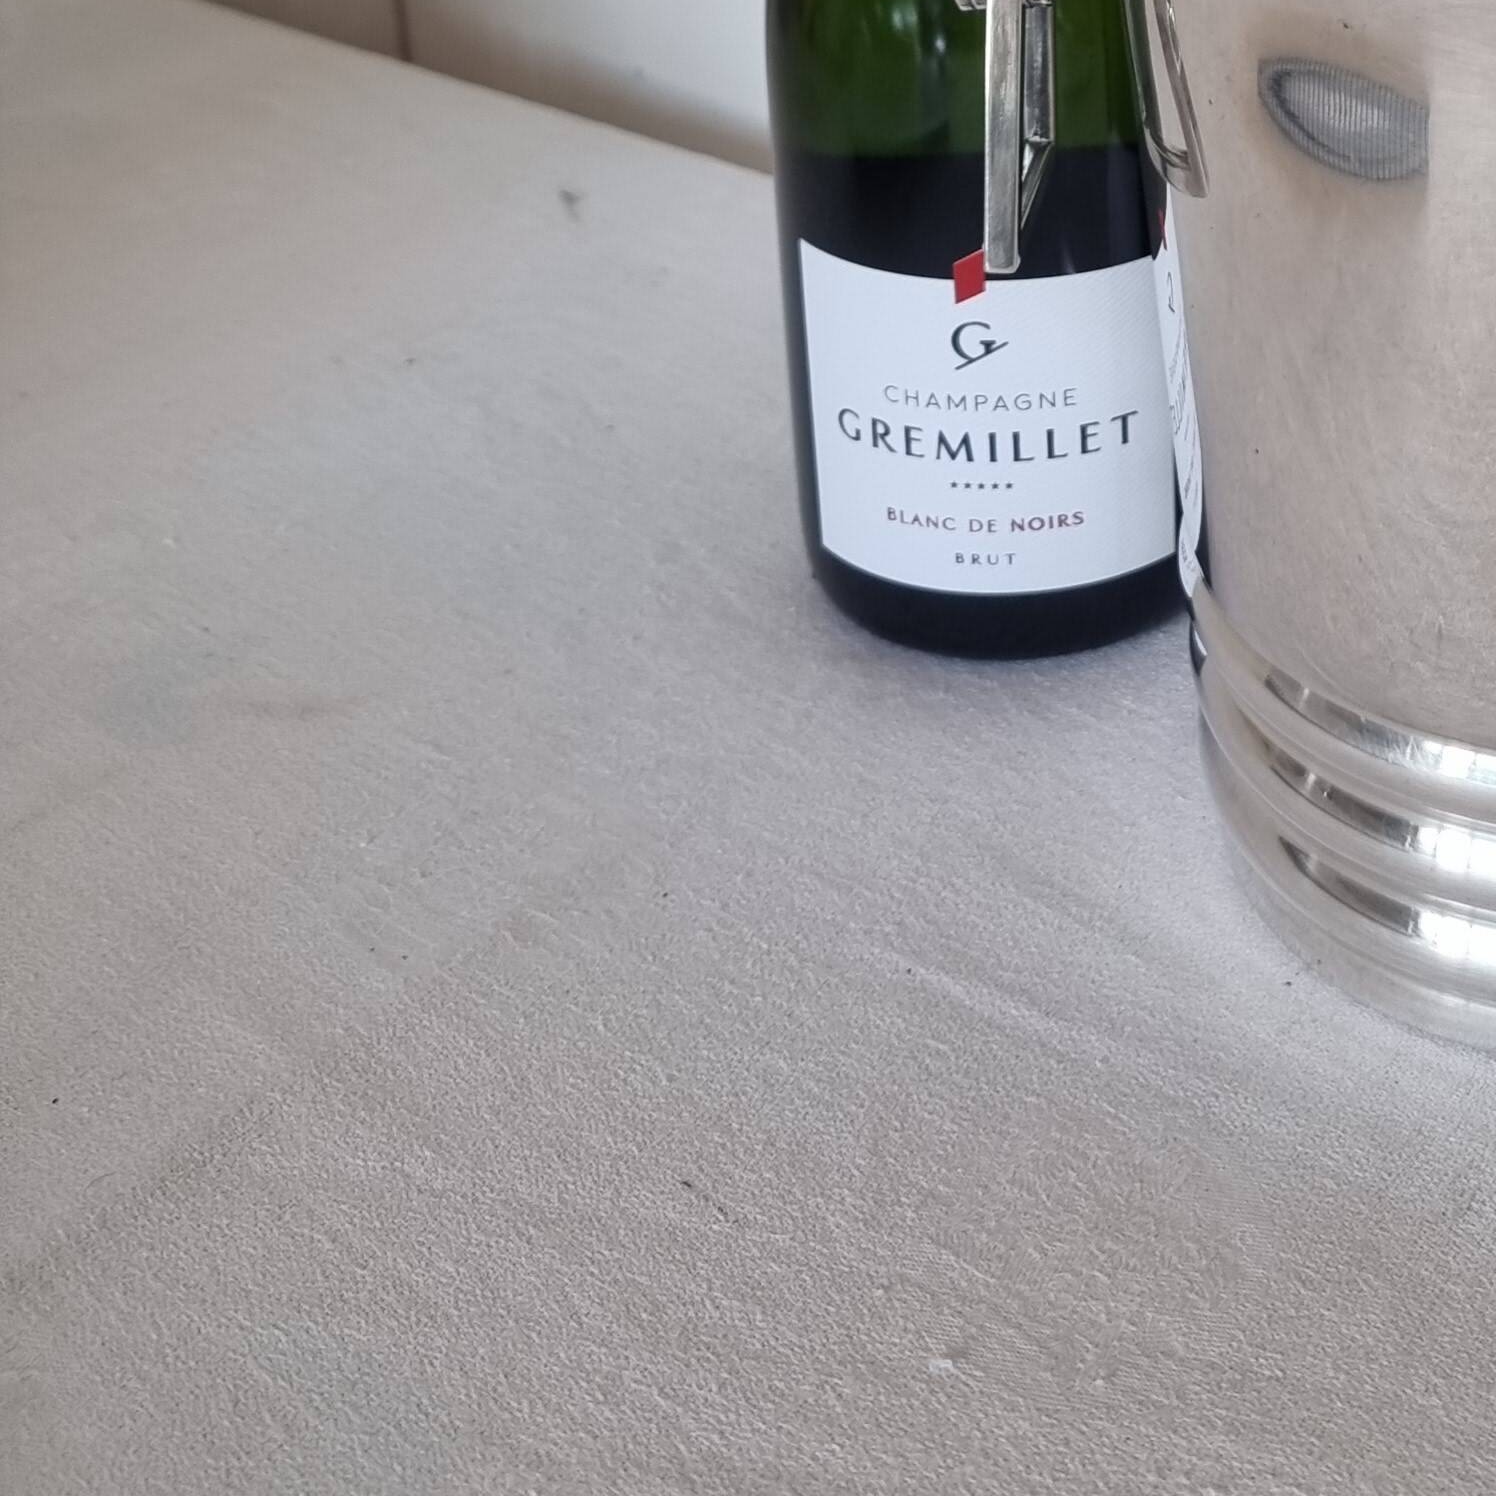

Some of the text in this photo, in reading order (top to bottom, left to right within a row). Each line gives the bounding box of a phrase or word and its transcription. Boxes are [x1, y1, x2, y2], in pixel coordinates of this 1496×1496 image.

[950, 320, 1009, 371] G
[883, 384, 1077, 412] CHAMPAGNE
[837, 407, 1139, 463] GREMILLET
[886, 506, 1085, 533] BLANC DE NOIRS
[954, 551, 1018, 566] BRUT
